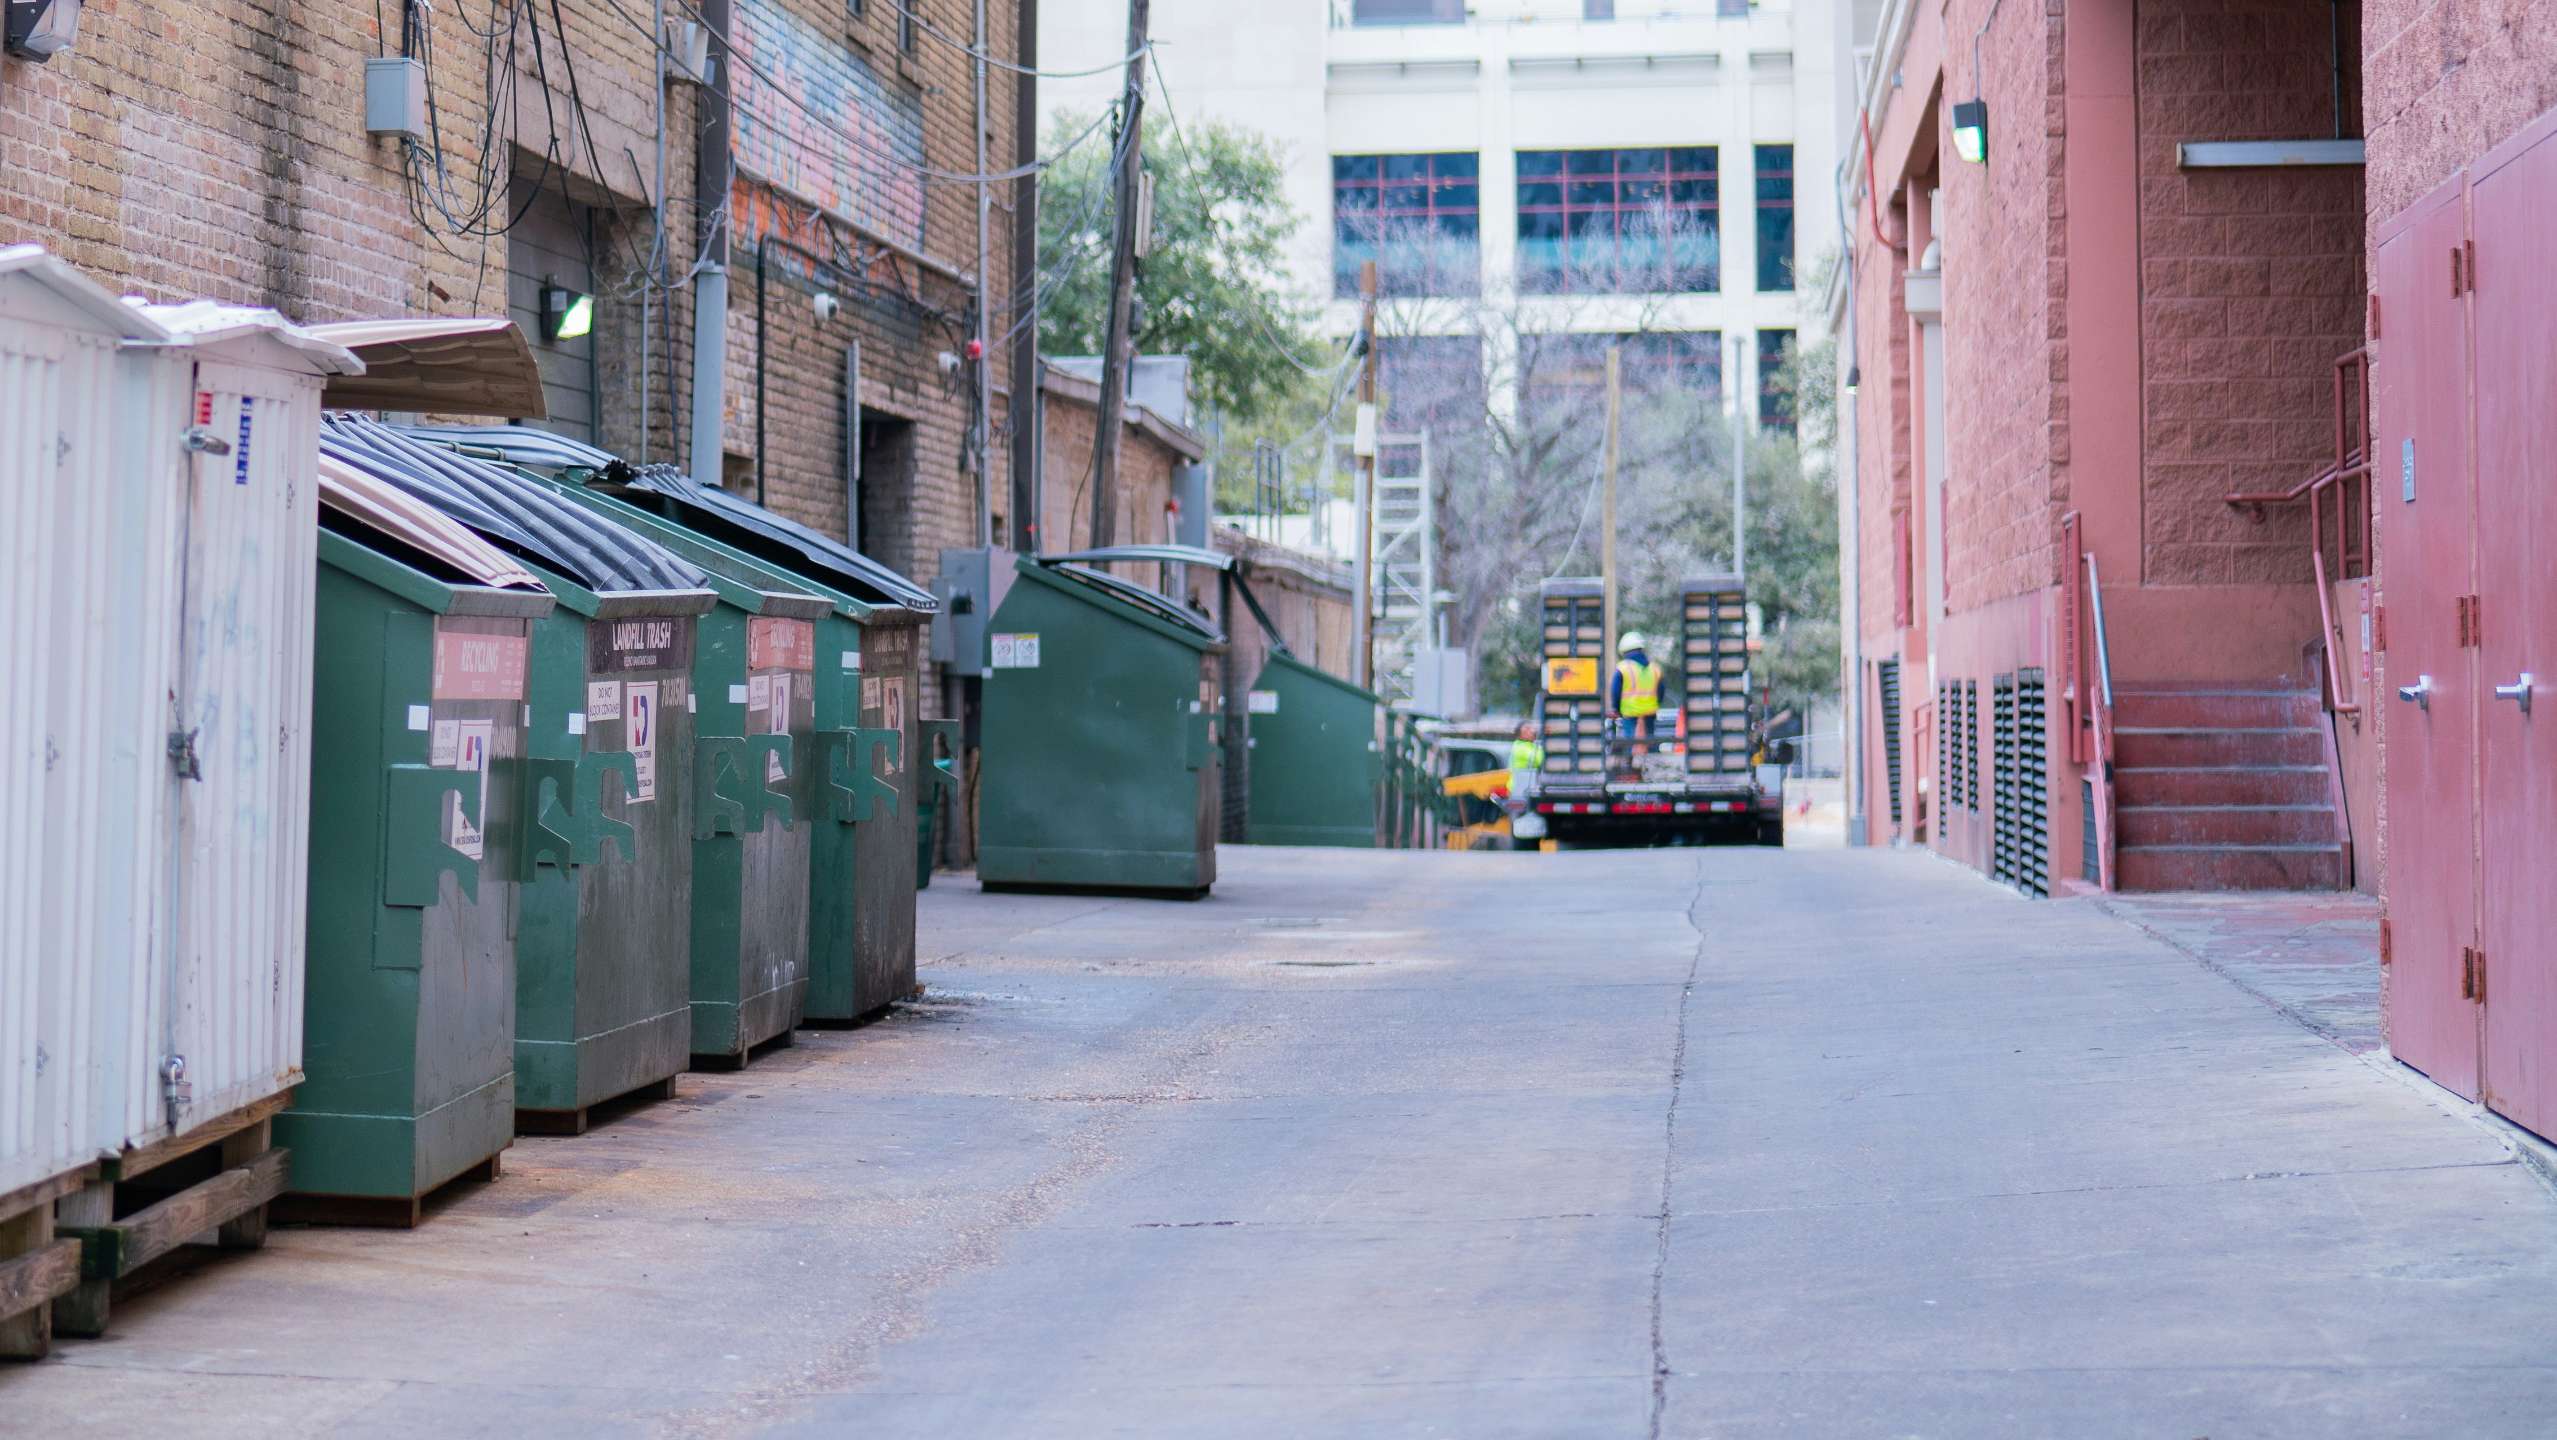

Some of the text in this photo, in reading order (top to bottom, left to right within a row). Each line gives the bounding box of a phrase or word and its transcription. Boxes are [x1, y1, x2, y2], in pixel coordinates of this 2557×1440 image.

[612, 622, 671, 650] LANDFILL TRASH
[461, 640, 499, 674] RECYCLING
